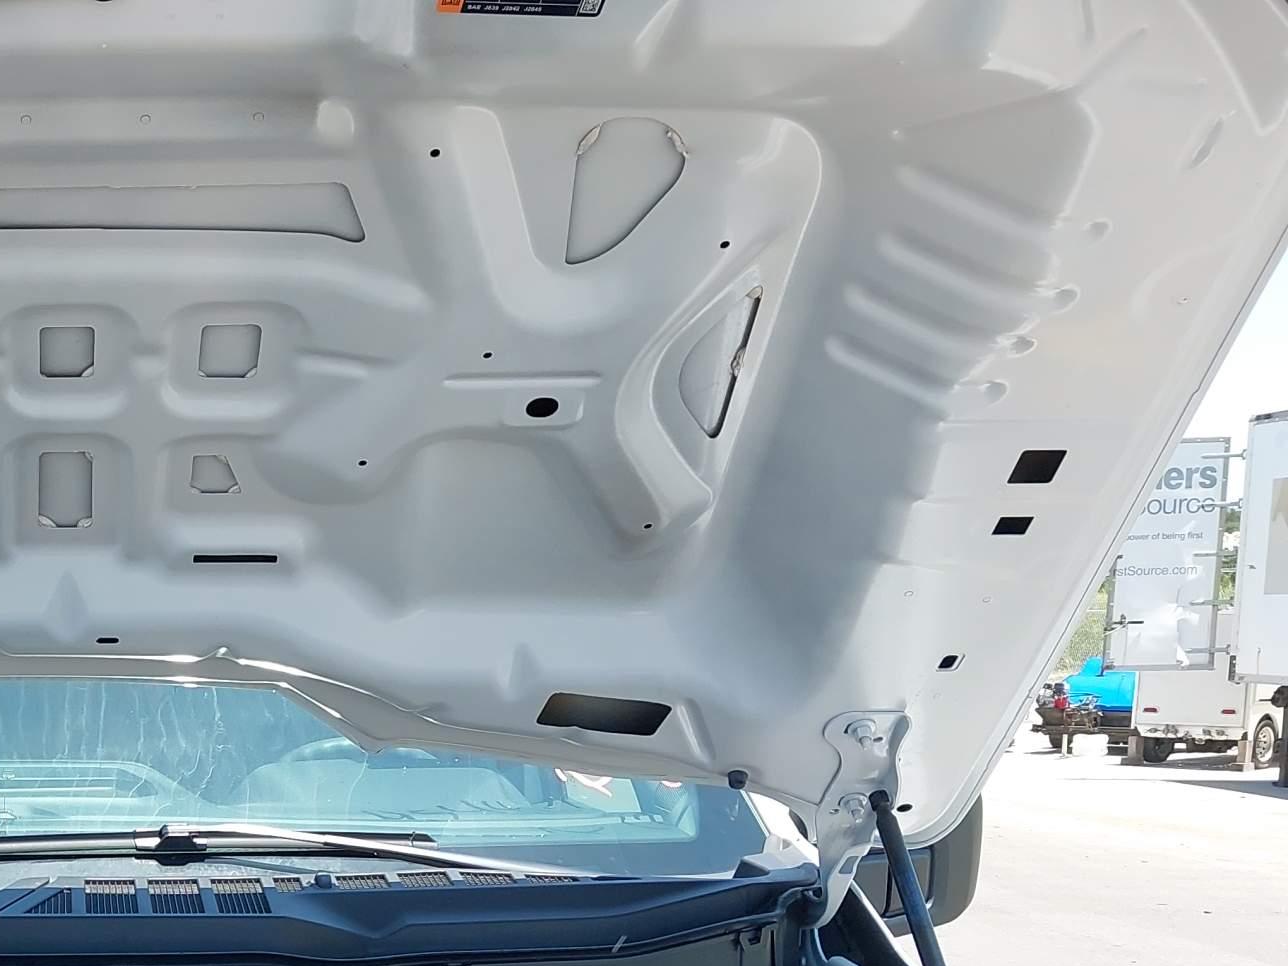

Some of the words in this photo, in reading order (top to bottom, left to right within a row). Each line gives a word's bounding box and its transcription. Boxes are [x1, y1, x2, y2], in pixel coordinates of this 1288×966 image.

[1141, 497, 1216, 516] ource
[1151, 532, 1160, 540] of
[1162, 532, 1186, 541] being
[1187, 531, 1204, 540] first
